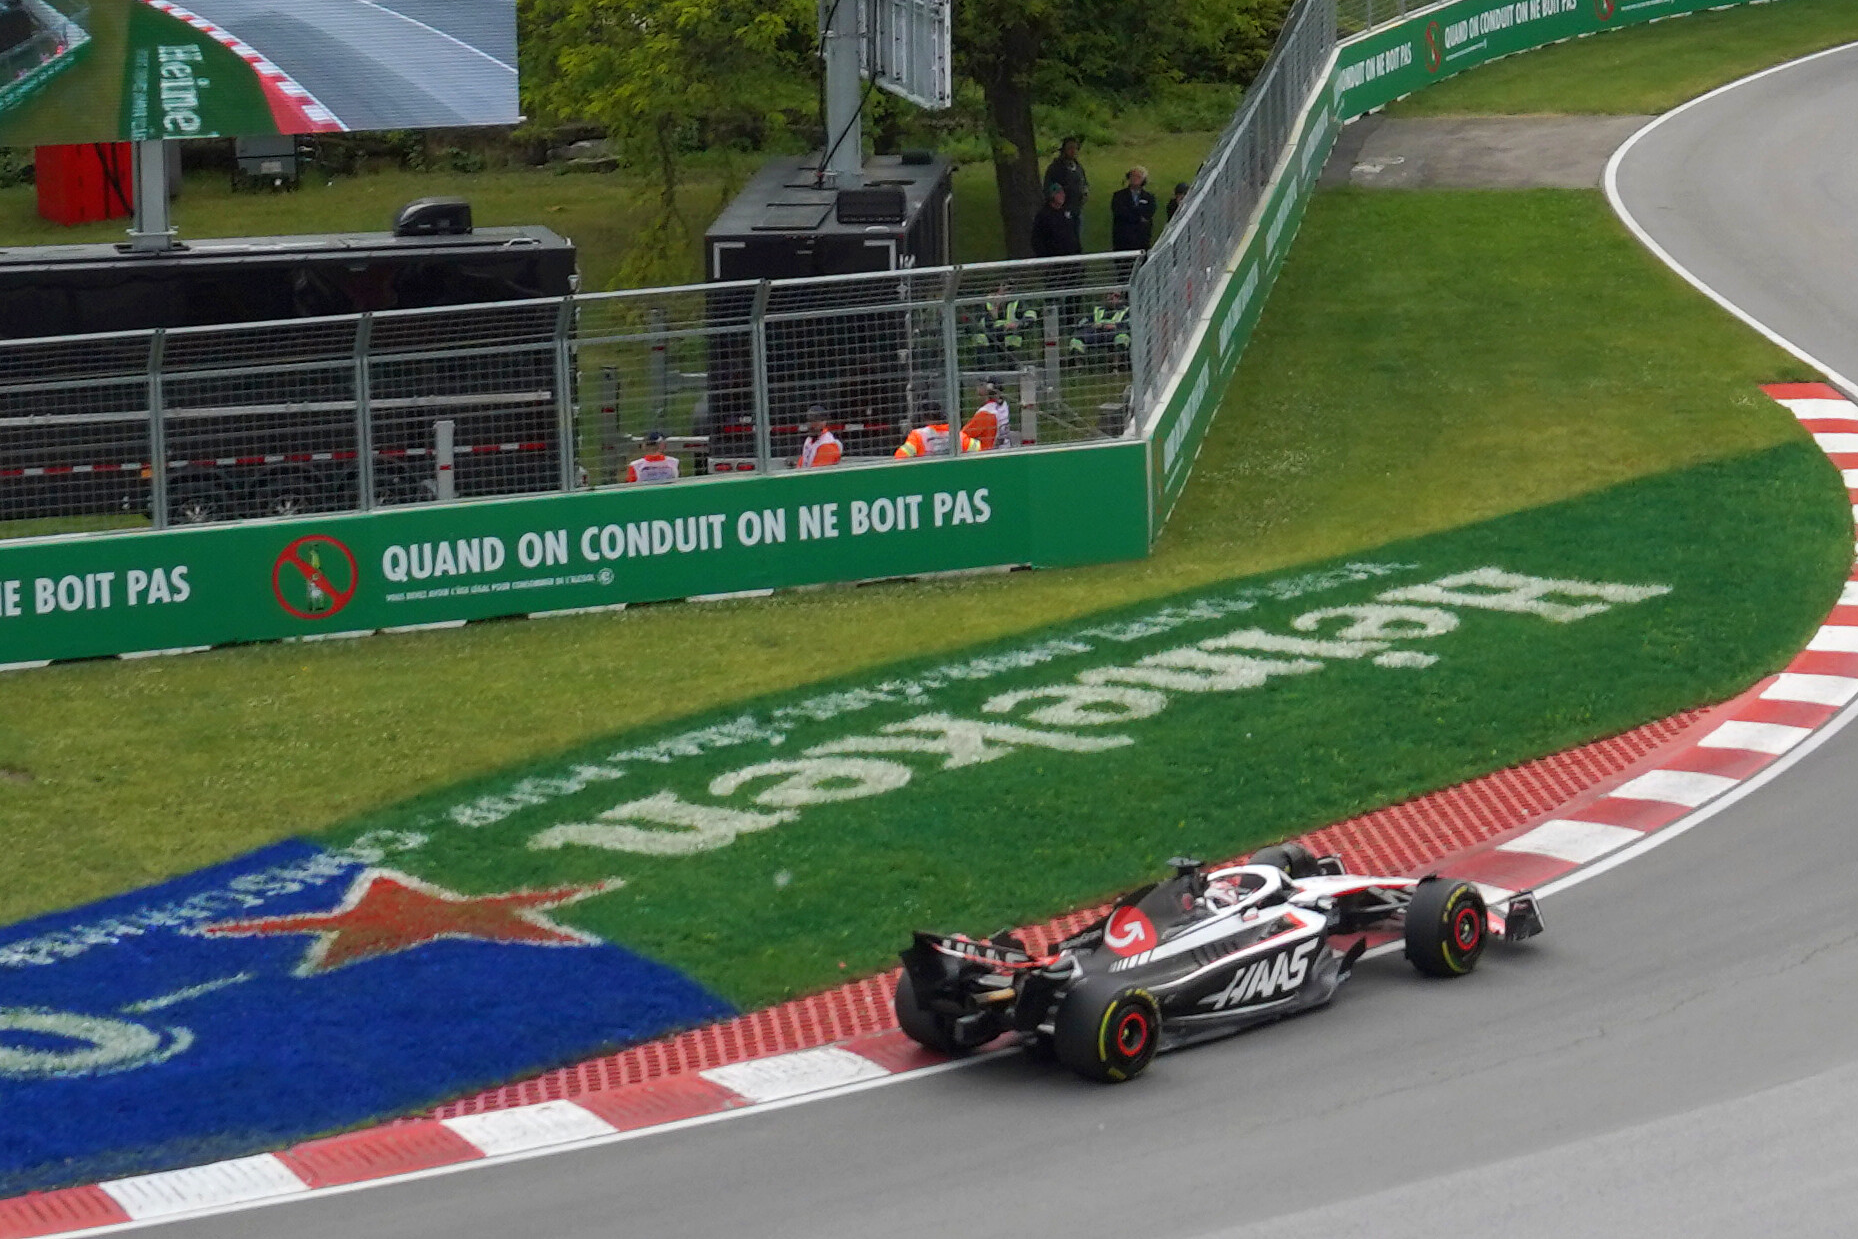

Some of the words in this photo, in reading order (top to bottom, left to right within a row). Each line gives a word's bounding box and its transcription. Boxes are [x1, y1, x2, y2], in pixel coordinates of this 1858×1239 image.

[158, 44, 220, 140] Heine
[383, 537, 505, 582] QUAND
[518, 530, 568, 568] ON
[581, 514, 726, 561] CONDUIT
[738, 508, 786, 546] ON
[799, 503, 838, 540] NE
[851, 495, 922, 535] BOIT
[934, 488, 991, 527] PAS
[35, 572, 115, 614] BOIT
[127, 566, 190, 605] PAS
[528, 567, 1675, 858] Heineken
[1197, 936, 1320, 1011] HAAS
